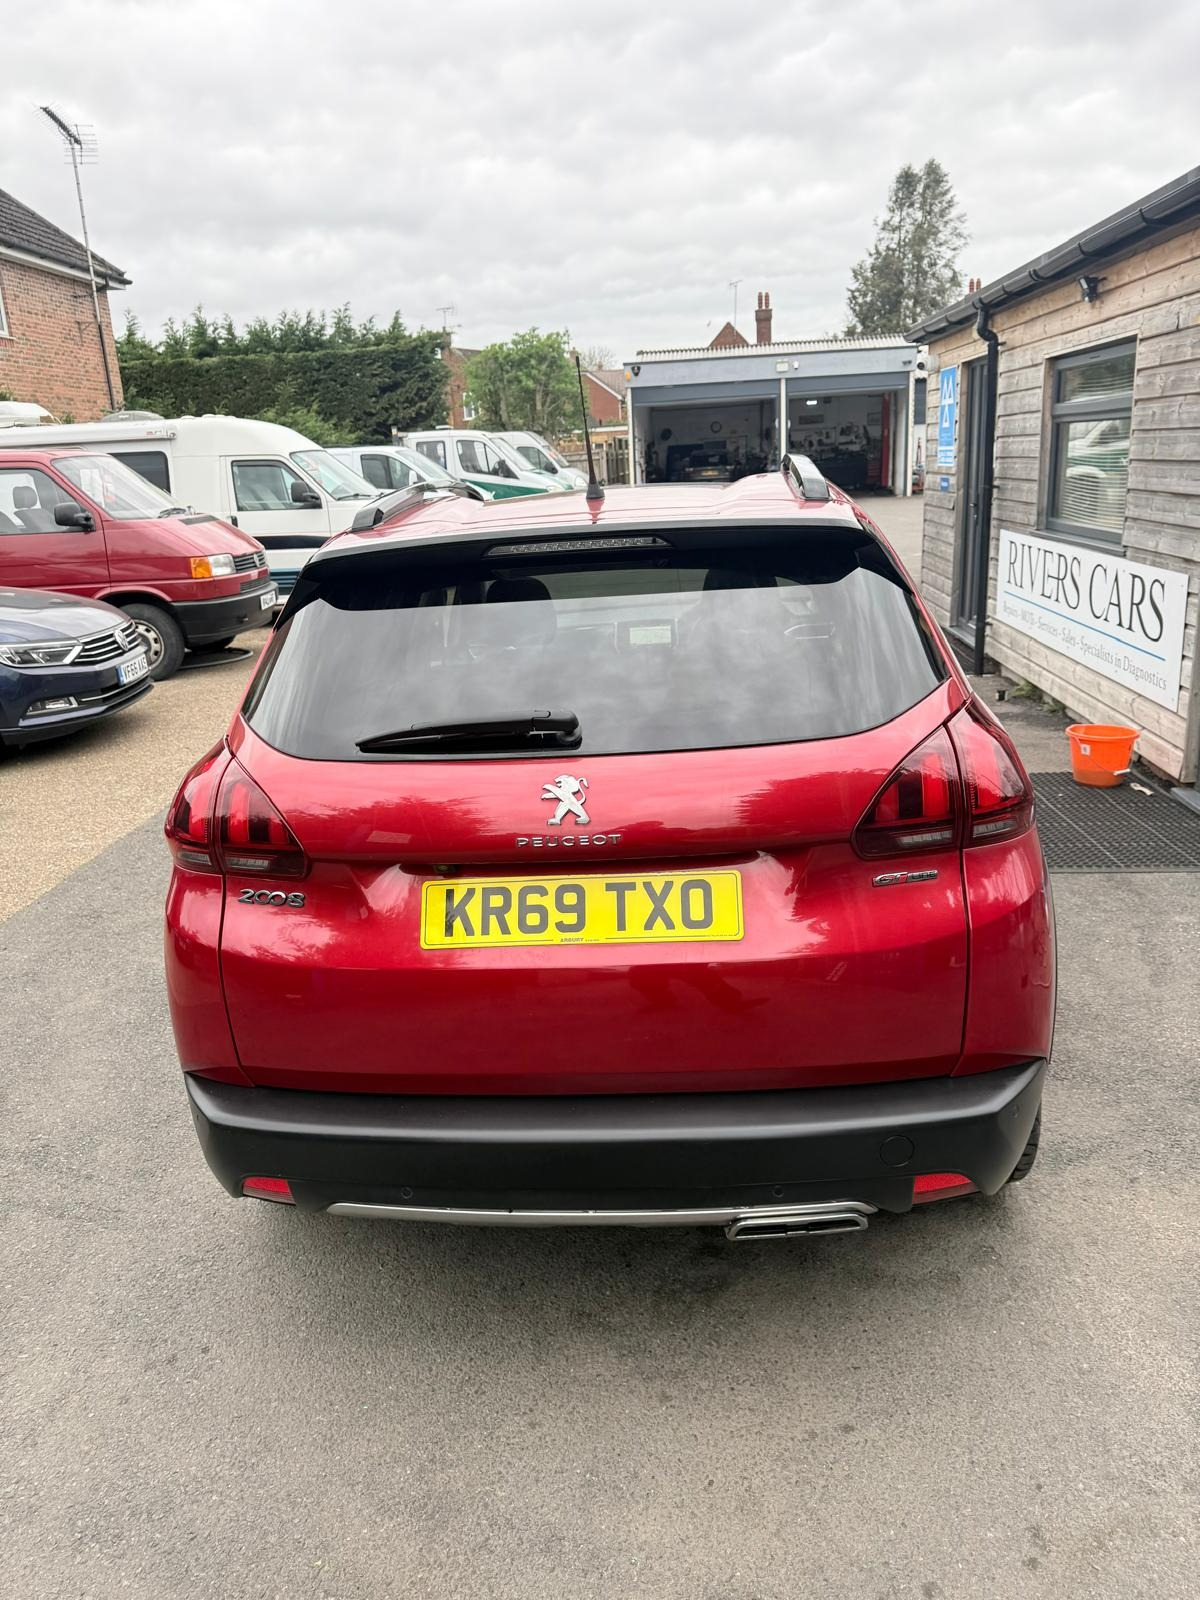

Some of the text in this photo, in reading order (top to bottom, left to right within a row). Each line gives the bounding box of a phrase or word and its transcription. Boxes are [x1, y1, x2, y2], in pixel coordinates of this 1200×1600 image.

[1007, 540, 1166, 643] RIVERS CARS
[1080, 635, 1114, 664] Specialists
[1114, 653, 1122, 669] in
[1123, 655, 1167, 690] Diagnostics
[516, 834, 622, 847] PEUGEOT
[238, 888, 305, 908] 2008
[873, 872, 908, 887] GT
[444, 878, 713, 938] KR69 TXO
